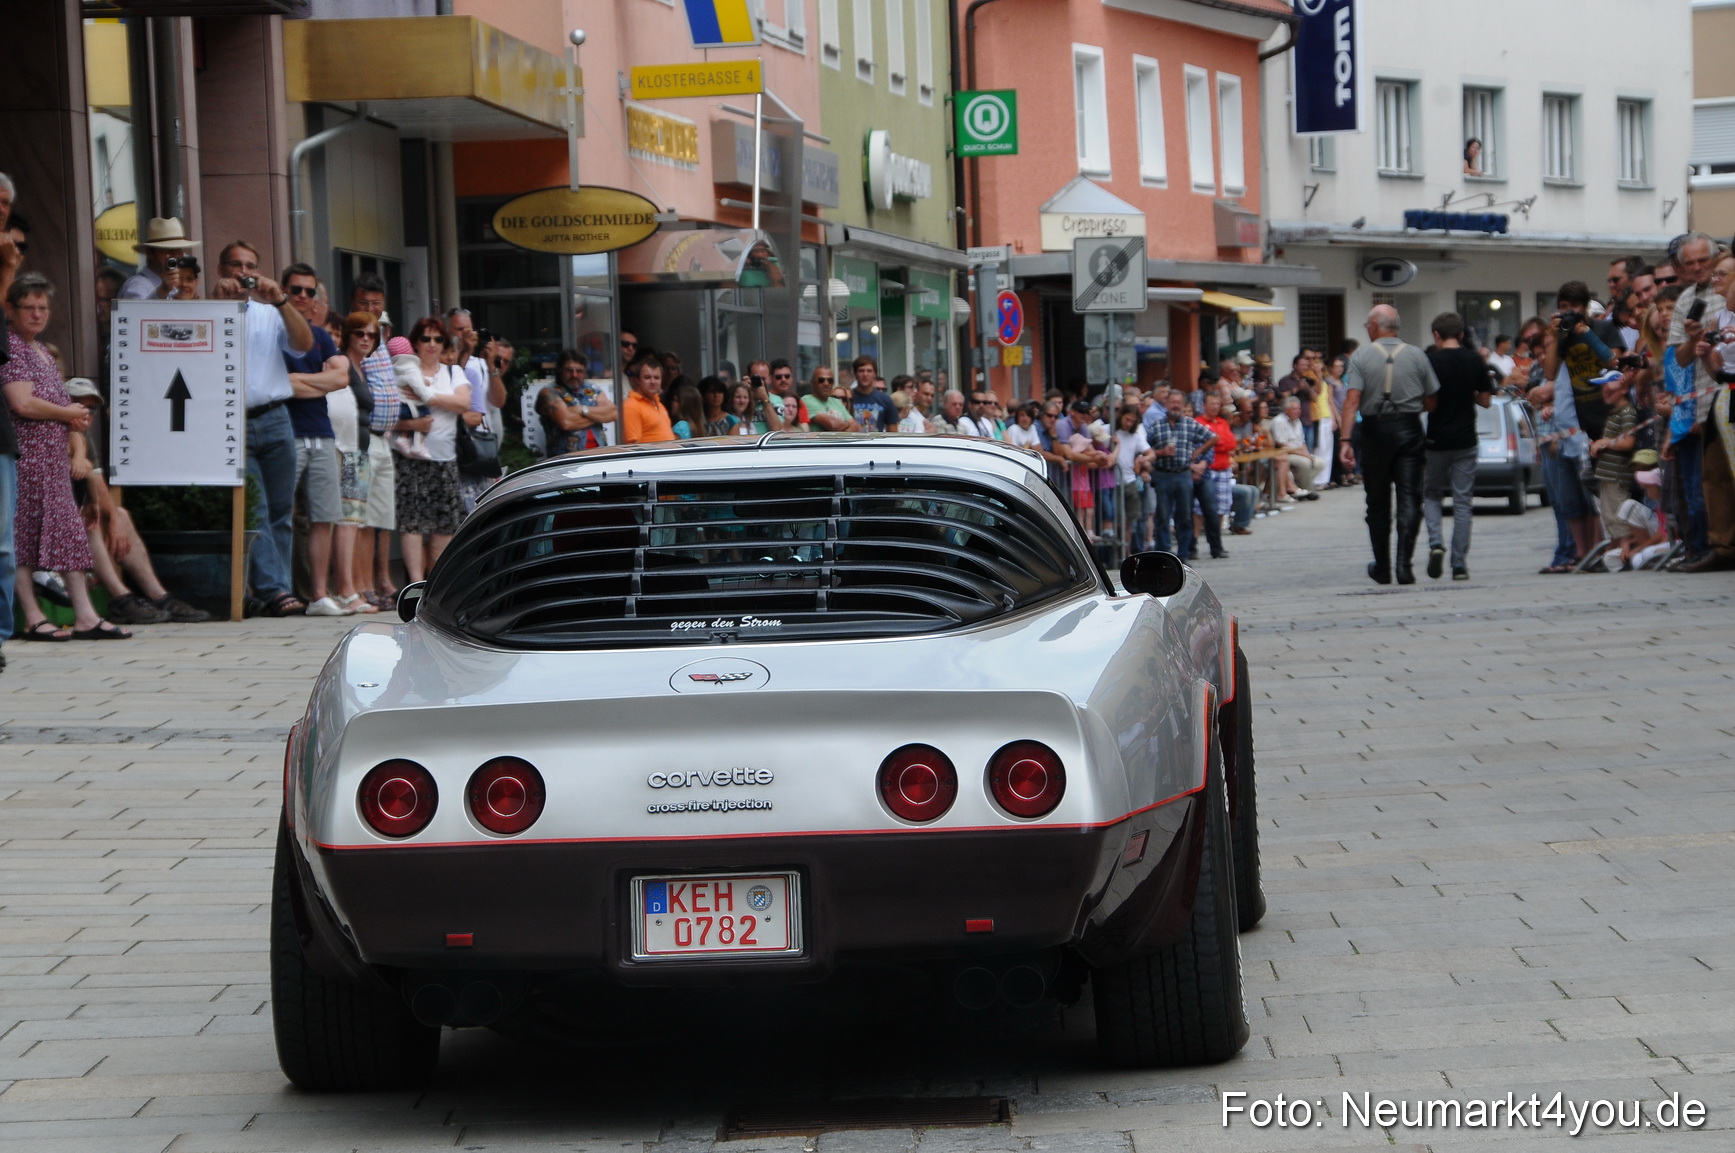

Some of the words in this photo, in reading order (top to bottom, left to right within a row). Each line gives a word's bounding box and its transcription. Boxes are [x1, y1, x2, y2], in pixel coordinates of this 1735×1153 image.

[637, 70, 741, 89] KLOSTERGASSE
[746, 70, 755, 83] 4
[501, 215, 528, 229] DIE
[531, 212, 655, 228] GOLDSCHMIEDE
[542, 233, 571, 243] JUTTA
[572, 232, 610, 242] ROTHER
[1093, 291, 1128, 304] ZONE
[117, 316, 131, 466] RESIDENZPLATZ
[223, 316, 237, 466] RESIDENZPLATZ
[670, 620, 707, 632] gegen
[711, 617, 735, 628] den
[739, 615, 782, 628] Strom
[647, 766, 774, 789] corvette
[653, 902, 661, 912] D
[669, 882, 733, 914] KEH
[674, 914, 758, 947] 0782
